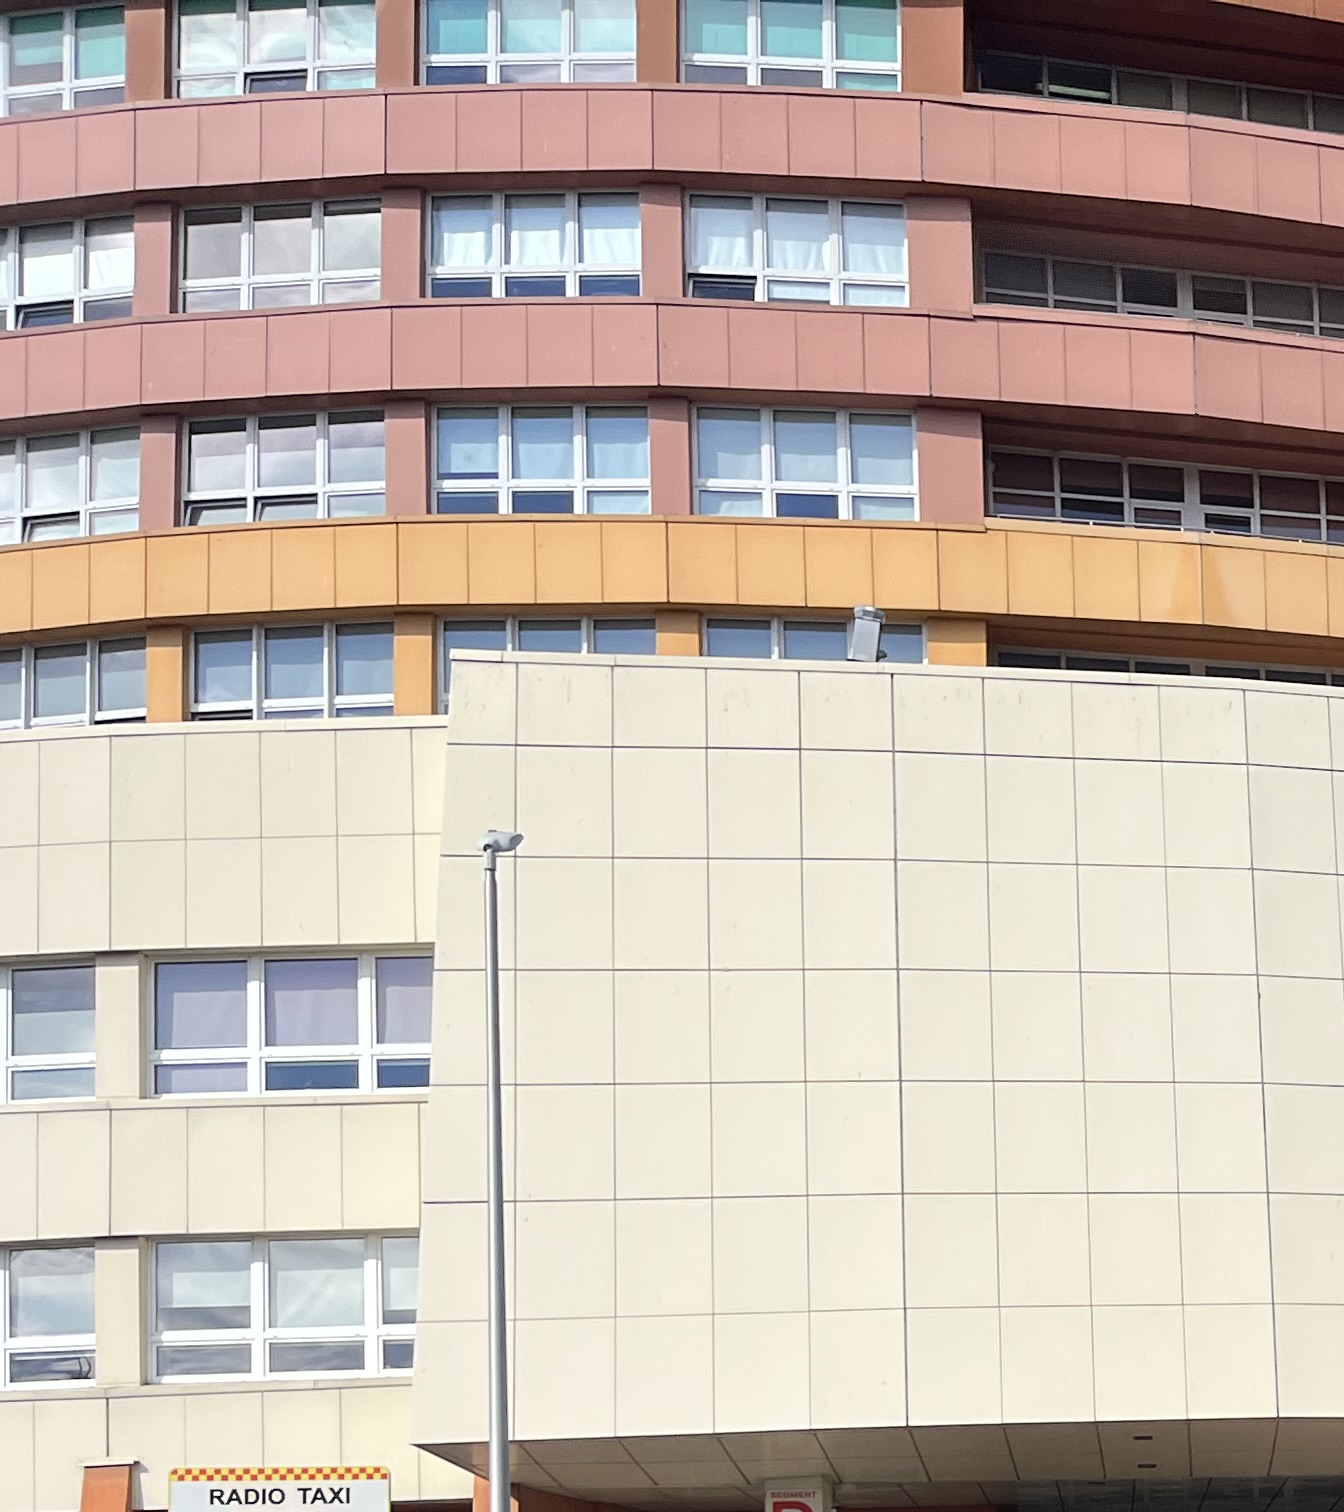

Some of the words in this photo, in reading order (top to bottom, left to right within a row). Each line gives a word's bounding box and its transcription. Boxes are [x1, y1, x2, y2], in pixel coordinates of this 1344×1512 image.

[209, 1488, 286, 1505] RADIO
[297, 1487, 351, 1504] TAXI
[770, 1490, 817, 1498] SEGMENT
